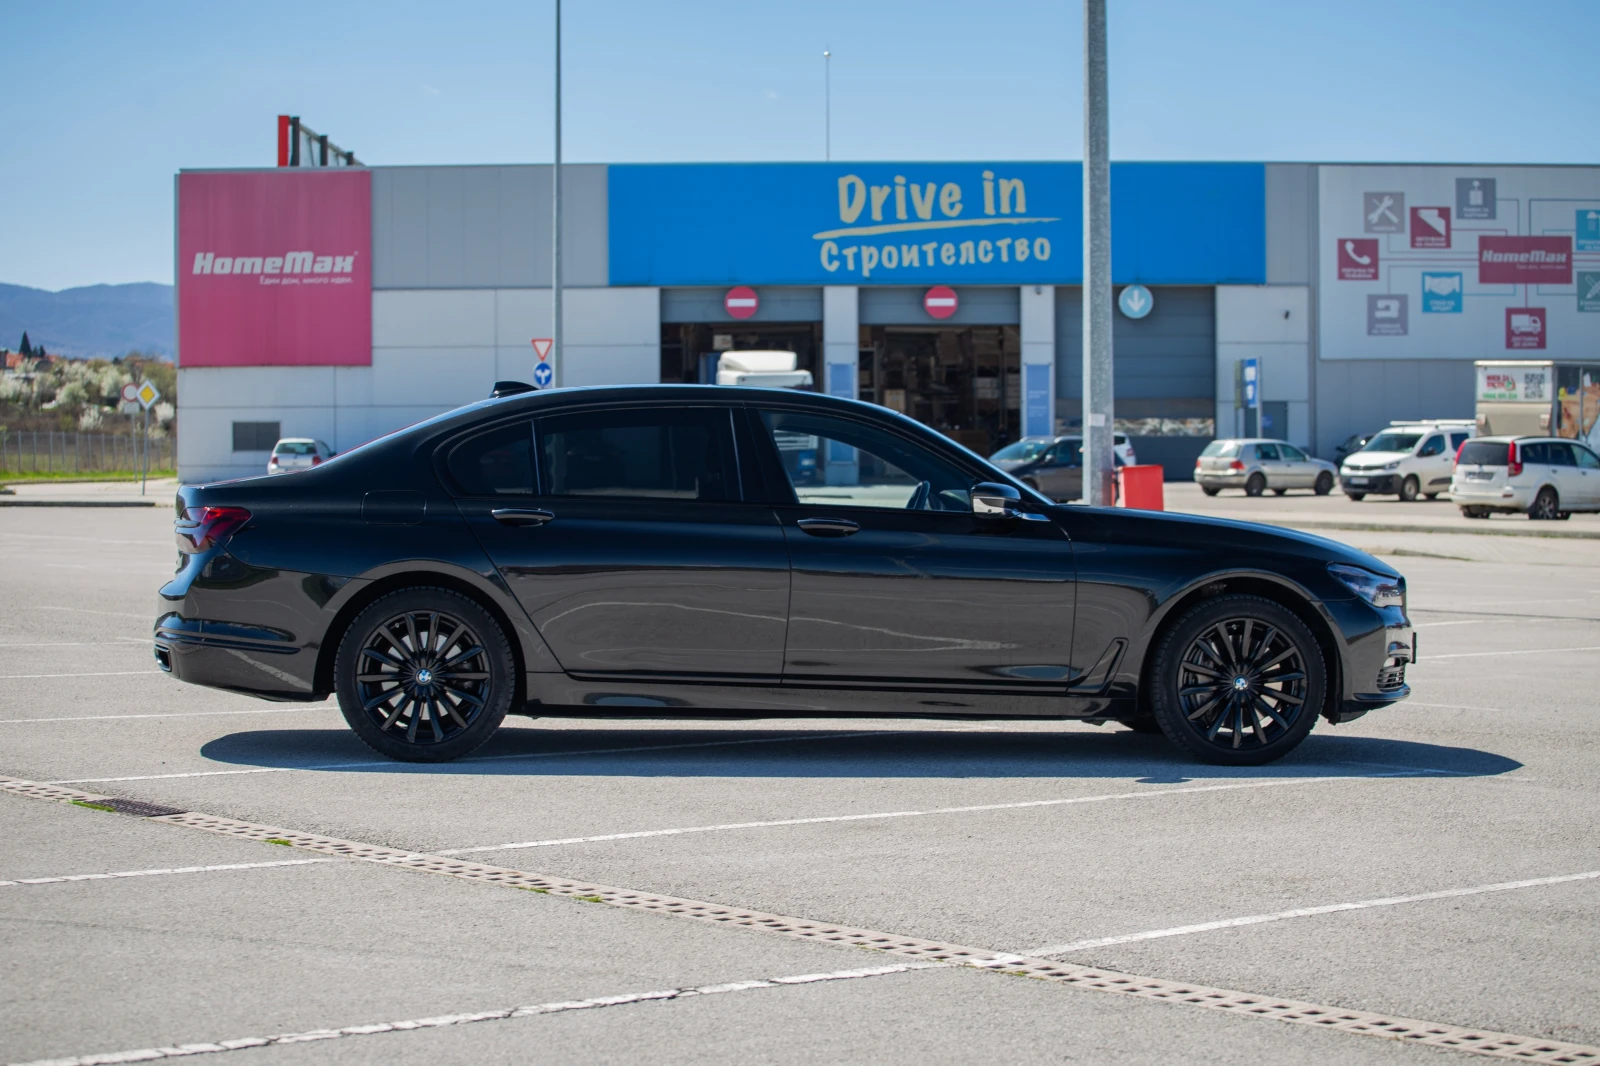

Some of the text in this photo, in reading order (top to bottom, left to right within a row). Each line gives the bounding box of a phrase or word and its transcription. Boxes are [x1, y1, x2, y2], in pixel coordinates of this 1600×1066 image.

[837, 170, 1027, 224] Drive in
[192, 251, 354, 275] HomeMax
[820, 237, 1051, 278] Строителство
[1482, 250, 1567, 263] HomeMax
[259, 275, 280, 285] Един
